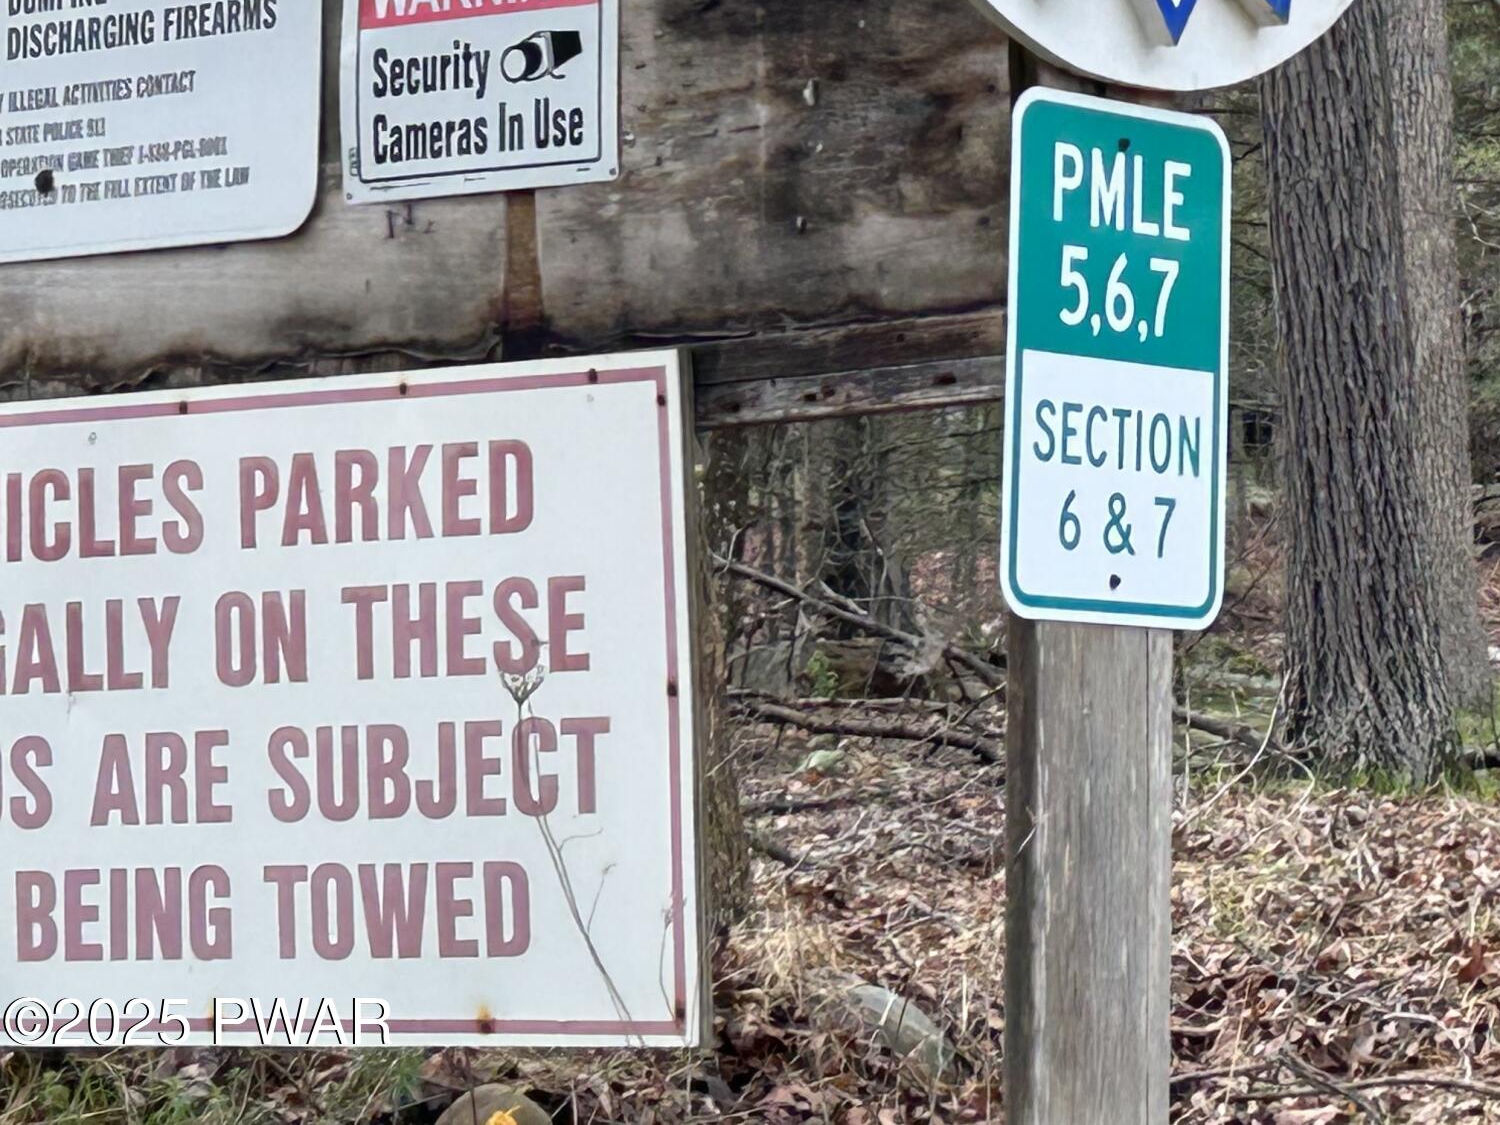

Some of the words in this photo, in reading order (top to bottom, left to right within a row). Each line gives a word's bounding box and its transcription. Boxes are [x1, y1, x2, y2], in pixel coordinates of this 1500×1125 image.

[7, 9, 154, 61] DISCHARGING
[372, 39, 490, 99] Security
[8, 86, 60, 113] ILLEGAL
[62, 77, 132, 107] ACTIVITIES
[136, 70, 196, 99] CONTACT
[373, 114, 488, 165] Cameras
[498, 102, 524, 152] In
[534, 97, 584, 149] Use
[5, 124, 40, 147] STATE
[1052, 141, 1192, 241] PMLE
[1058, 244, 1180, 343] 5,6,7
[1033, 398, 1201, 477] SECTION
[6, 459, 204, 563] ICLES
[238, 438, 535, 550] PARKED
[1059, 489, 1082, 551] 6
[1103, 491, 1136, 556] &
[1154, 496, 1177, 559] 7
[0, 595, 182, 697] ALLY
[213, 589, 309, 688] ON
[340, 574, 591, 681] THESE
[90, 729, 234, 827] ARE
[266, 716, 611, 823] SUBJECT
[15, 865, 233, 964] BEING
[263, 860, 532, 961] TOWED
